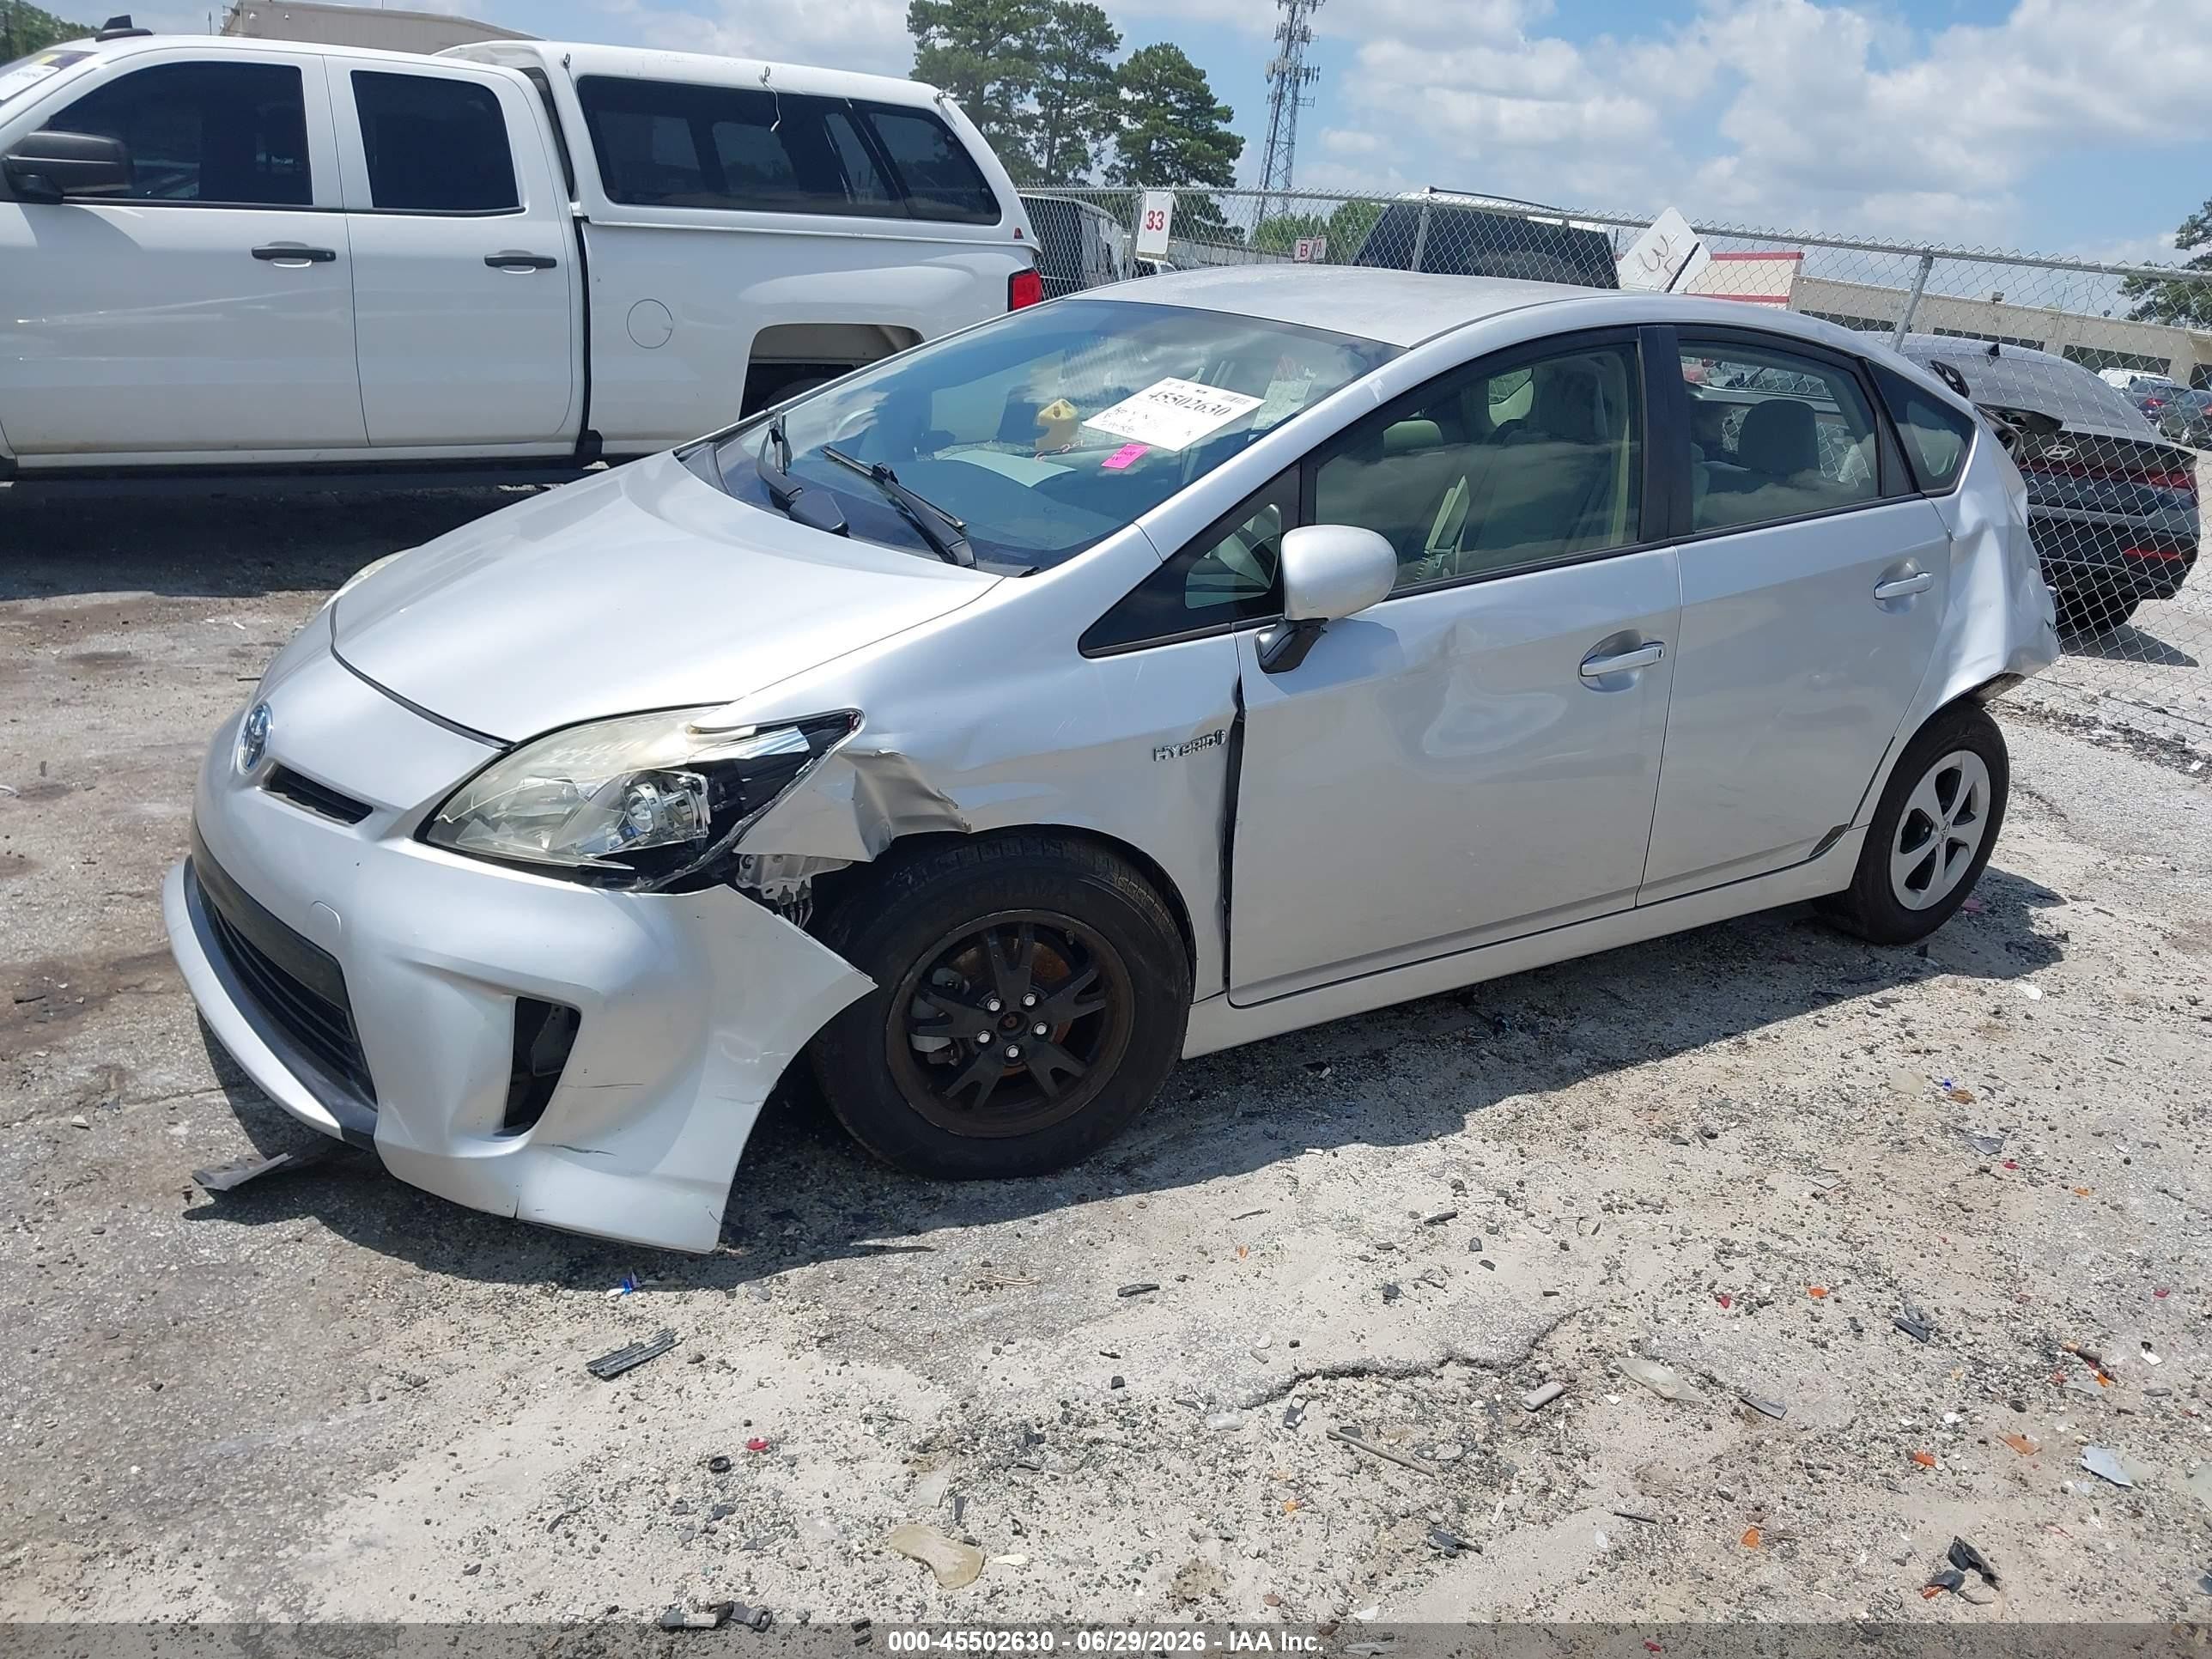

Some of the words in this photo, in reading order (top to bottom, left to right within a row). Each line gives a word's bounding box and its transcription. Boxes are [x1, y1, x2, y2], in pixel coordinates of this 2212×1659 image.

[1146, 210, 1165, 232] 33
[1148, 389, 1231, 418] 45502630
[1153, 734, 1217, 763] HYBRID
